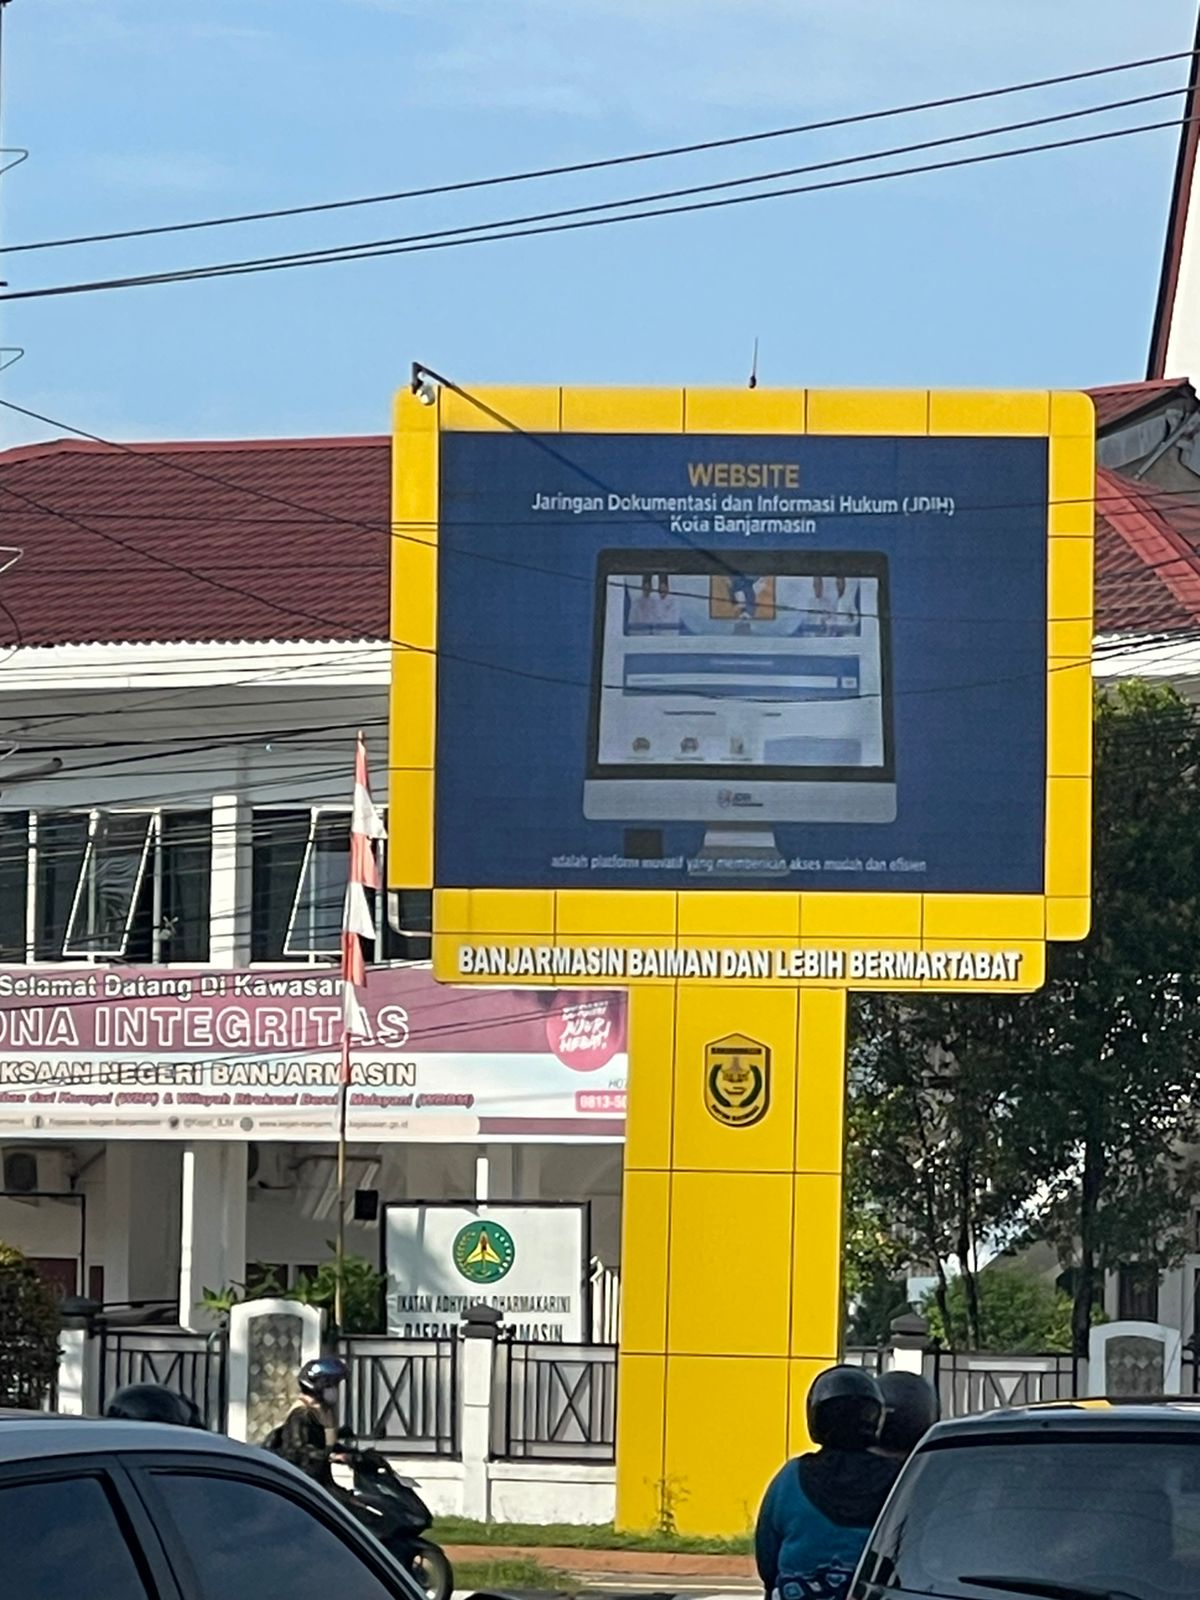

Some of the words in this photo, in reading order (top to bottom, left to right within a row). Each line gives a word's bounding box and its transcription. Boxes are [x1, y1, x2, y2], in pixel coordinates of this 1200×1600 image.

[688, 464, 799, 488] WEBSITE
[532, 492, 603, 514] Jaringan
[608, 493, 716, 511] Dokumentasi
[721, 494, 752, 512] dan
[757, 494, 835, 513] Informasi
[840, 496, 898, 513] Hukum
[671, 516, 709, 533] Kota
[714, 515, 816, 537] Banjarmasin
[790, 858, 821, 871] akses
[866, 858, 886, 871] dan
[458, 946, 627, 976] BANJARMASIN
[629, 948, 720, 977] BAIMAN
[722, 949, 772, 977] DAN
[776, 950, 845, 978] LEBIH
[850, 951, 1022, 980] BERMARTABAT
[0, 975, 97, 997] Selamat
[105, 975, 191, 1000] Datang
[200, 975, 226, 996] Di
[99, 1061, 203, 1085] NEGERI
[211, 1061, 416, 1086] BANJARMASIN
[397, 1295, 433, 1313] IKATAN
[491, 1295, 571, 1313] DHARMAKARINI
